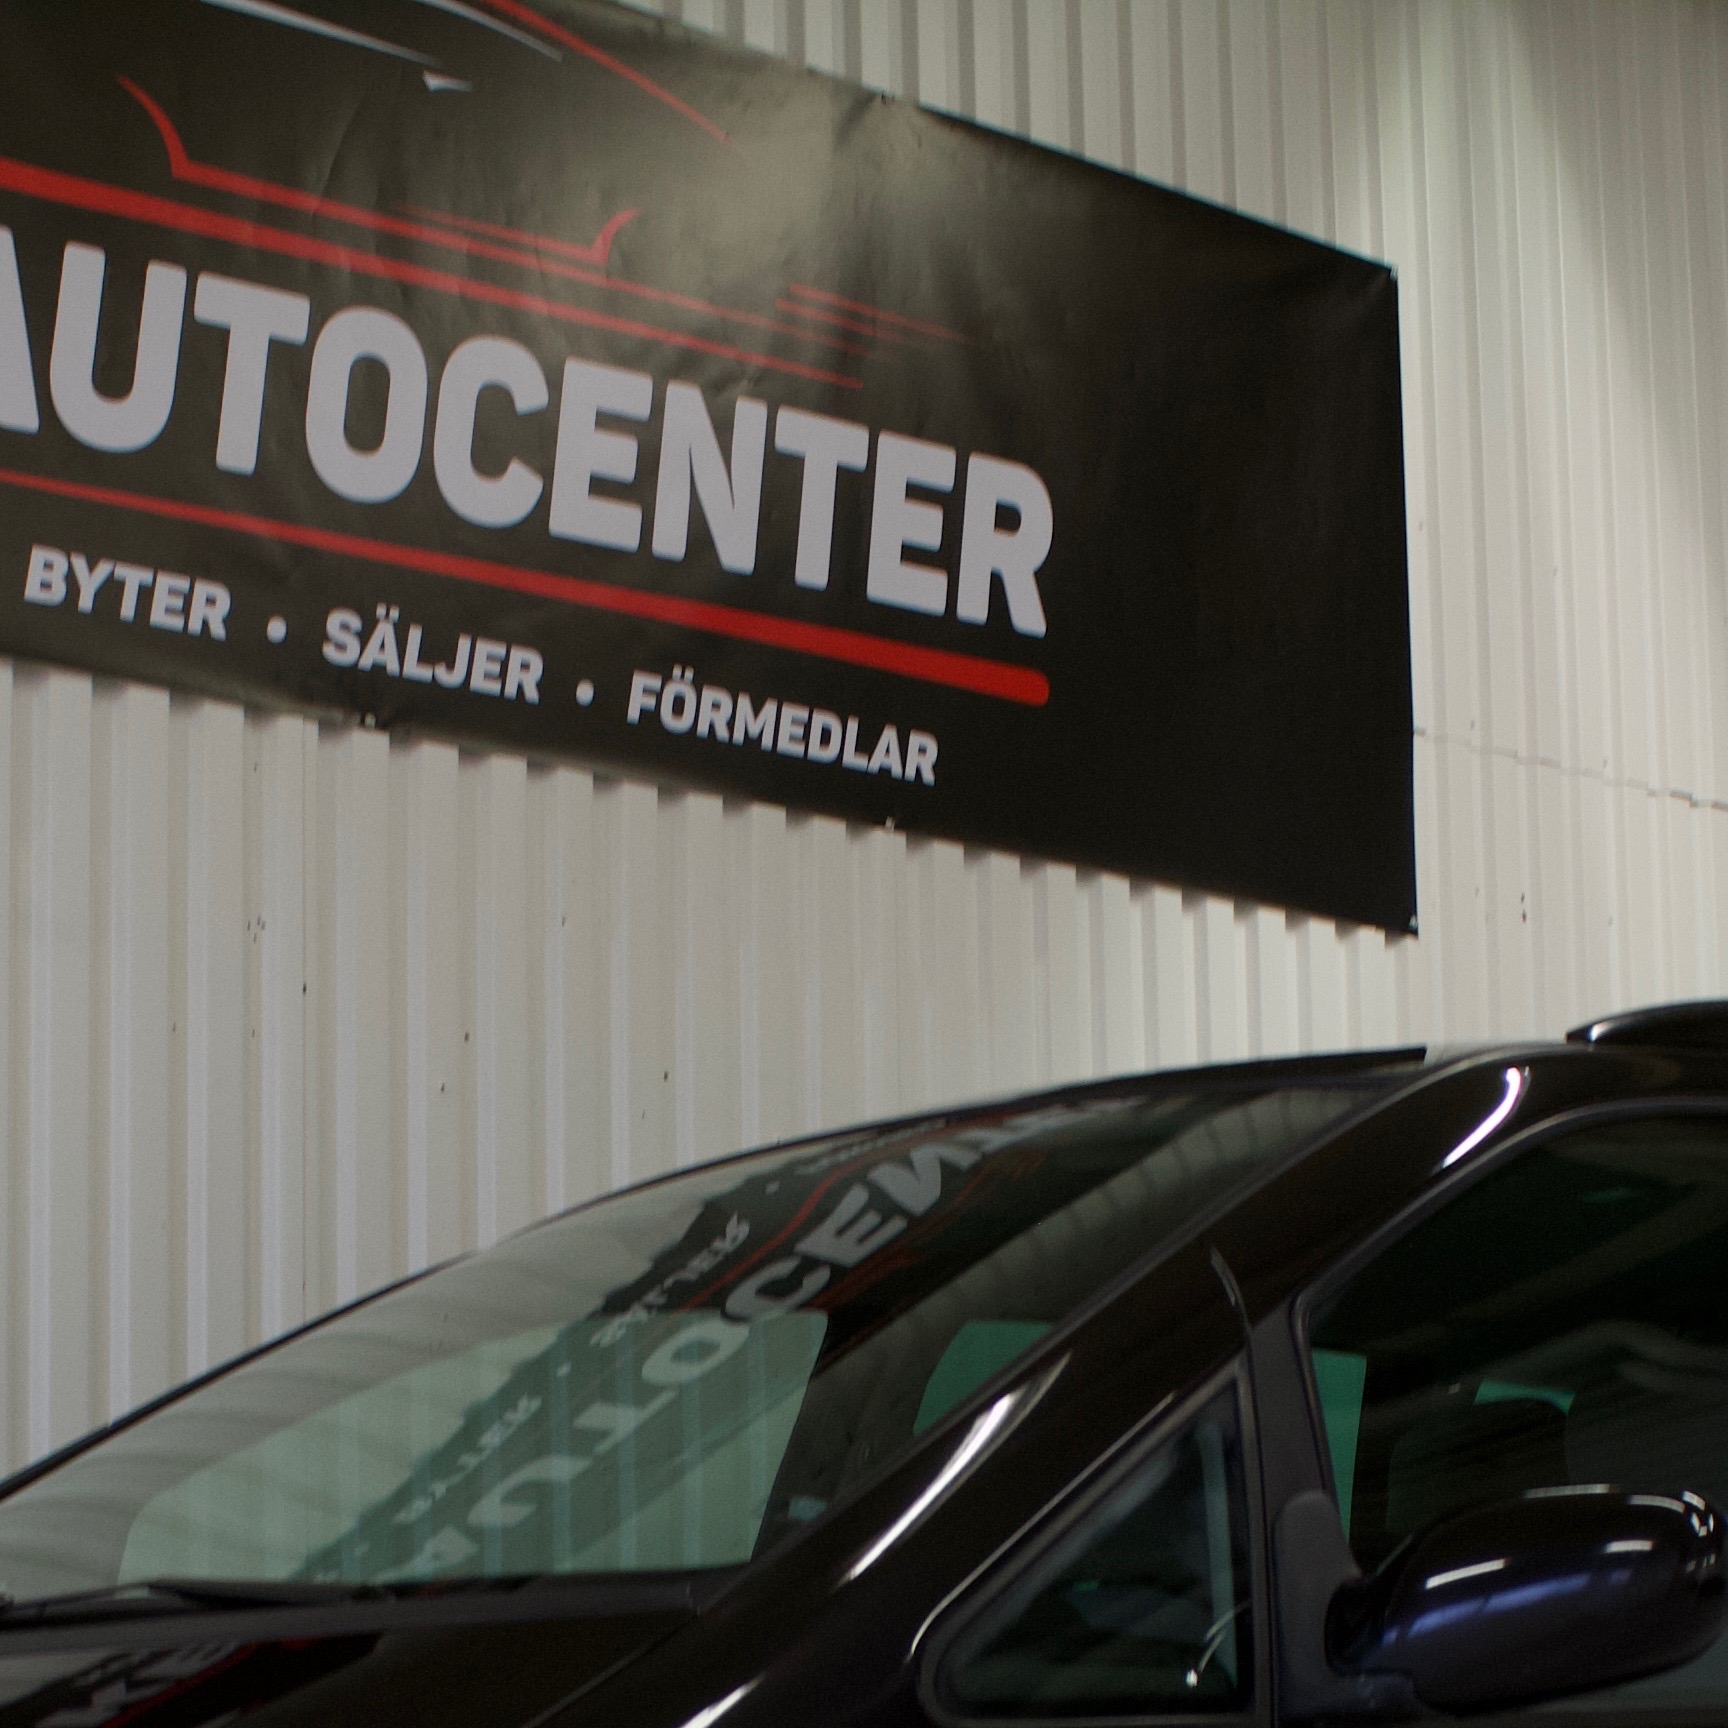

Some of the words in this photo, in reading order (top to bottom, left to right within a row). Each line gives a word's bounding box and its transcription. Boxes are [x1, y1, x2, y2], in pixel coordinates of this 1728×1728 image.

[23, 544, 232, 641] BYTER
[321, 602, 545, 703] SÄLJER
[626, 666, 940, 786] FÖRMEDLAR
